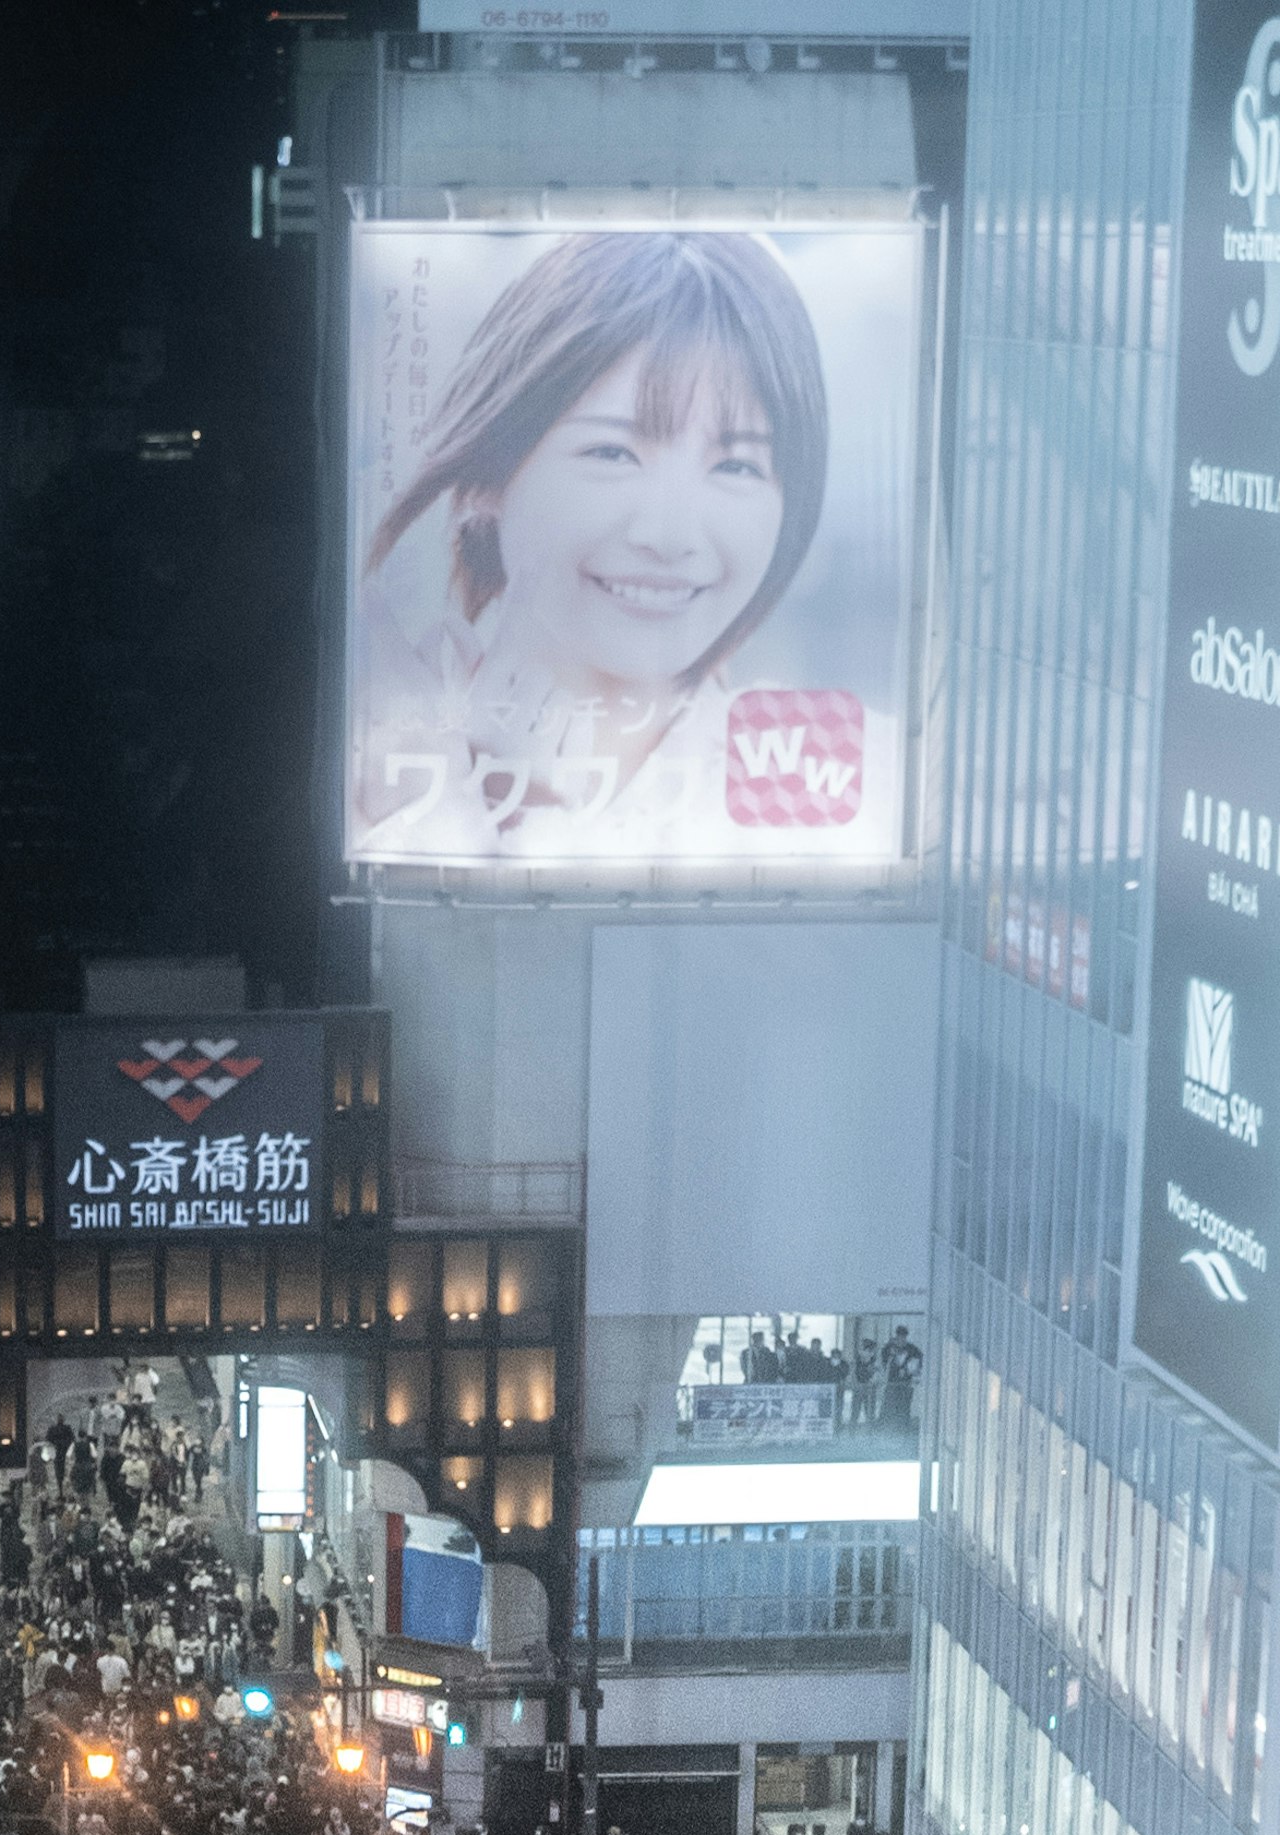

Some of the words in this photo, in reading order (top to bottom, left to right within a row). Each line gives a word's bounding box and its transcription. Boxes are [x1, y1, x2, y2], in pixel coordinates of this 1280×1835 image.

[68, 1132, 311, 1197] 心斎橋筋
[69, 1203, 121, 1229] SHIN
